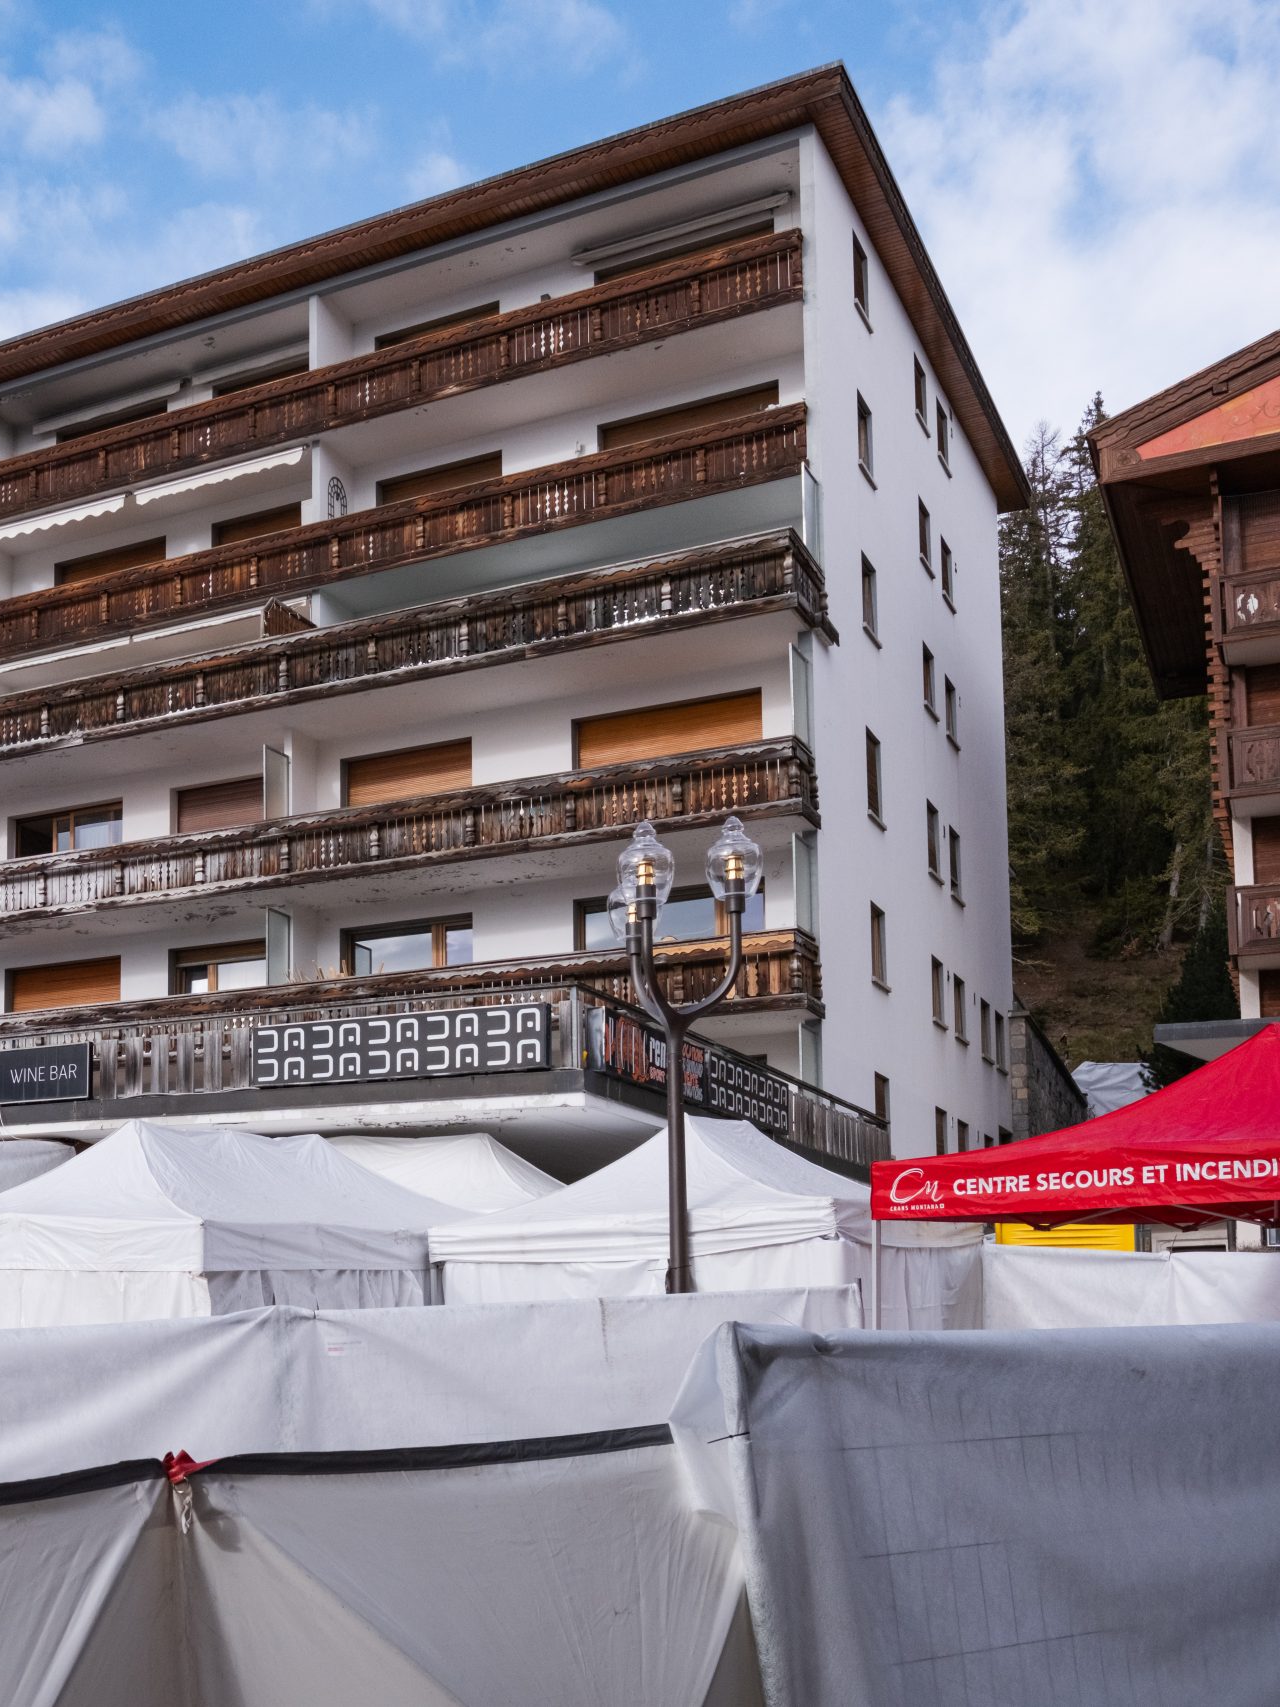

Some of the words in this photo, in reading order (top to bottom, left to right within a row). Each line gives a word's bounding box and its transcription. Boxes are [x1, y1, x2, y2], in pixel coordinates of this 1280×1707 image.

[10, 1067, 46, 1084] WINE
[49, 1063, 78, 1081] BAR
[953, 1175, 1030, 1196] CENTRE
[1036, 1167, 1135, 1191] SECOURS
[1142, 1164, 1169, 1184] ET
[910, 1203, 939, 1211] MONTANA
